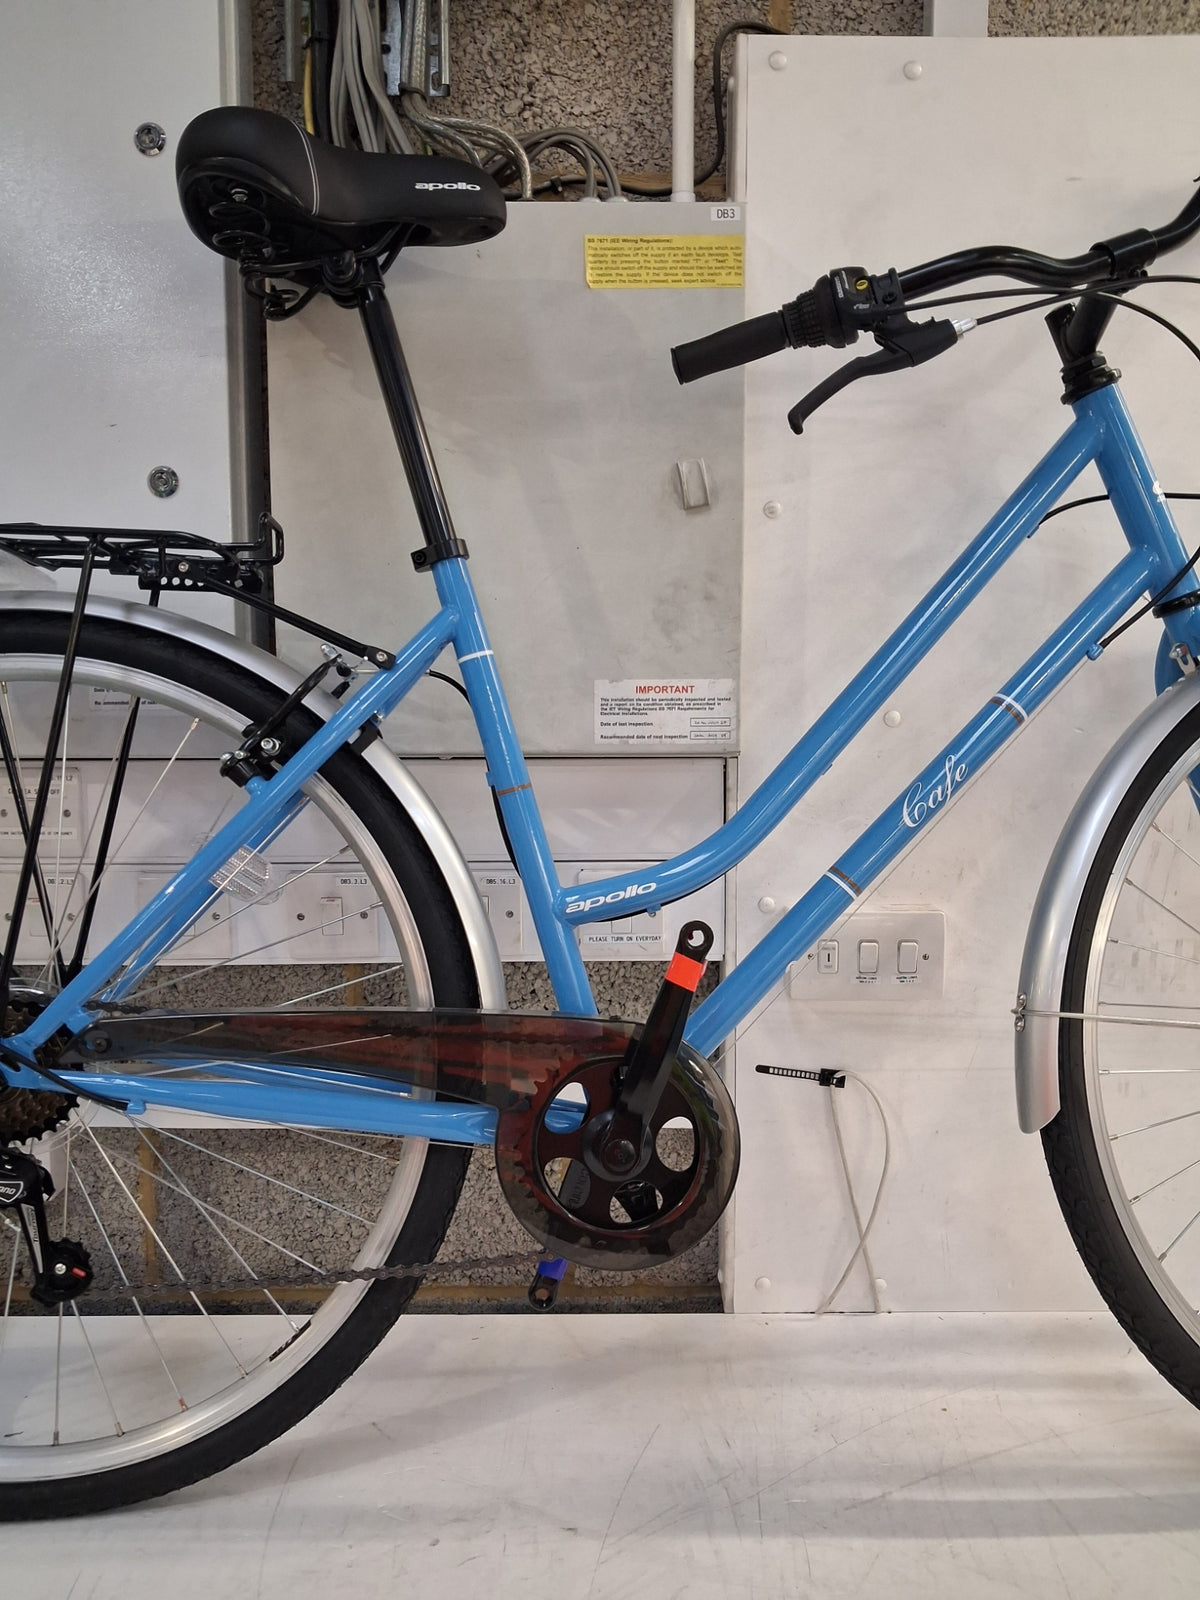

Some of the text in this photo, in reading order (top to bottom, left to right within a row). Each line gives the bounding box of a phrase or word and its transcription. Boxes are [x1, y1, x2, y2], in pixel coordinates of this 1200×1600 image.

[415, 182, 481, 190] apollo
[716, 208, 736, 218] DB3
[636, 686, 695, 694] IMPORTANT
[566, 882, 656, 913] apollo
